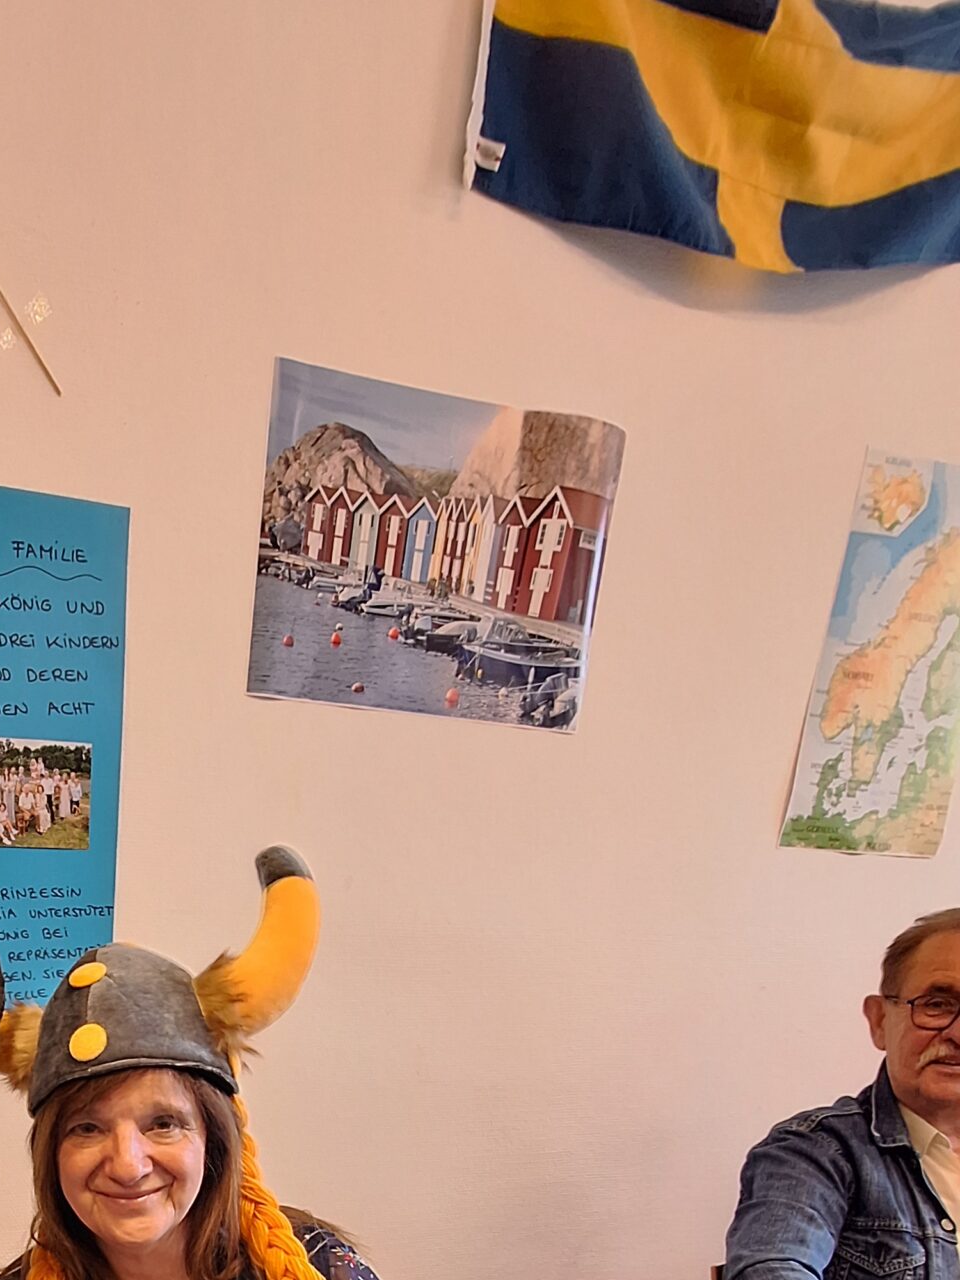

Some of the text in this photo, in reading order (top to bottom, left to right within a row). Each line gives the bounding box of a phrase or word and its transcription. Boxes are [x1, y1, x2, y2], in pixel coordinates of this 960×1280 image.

[67, 601, 104, 615] UND
[27, 668, 88, 682] DEREN
[48, 702, 95, 716] ACHT
[29, 905, 113, 918] UNTERSTÜTZT
